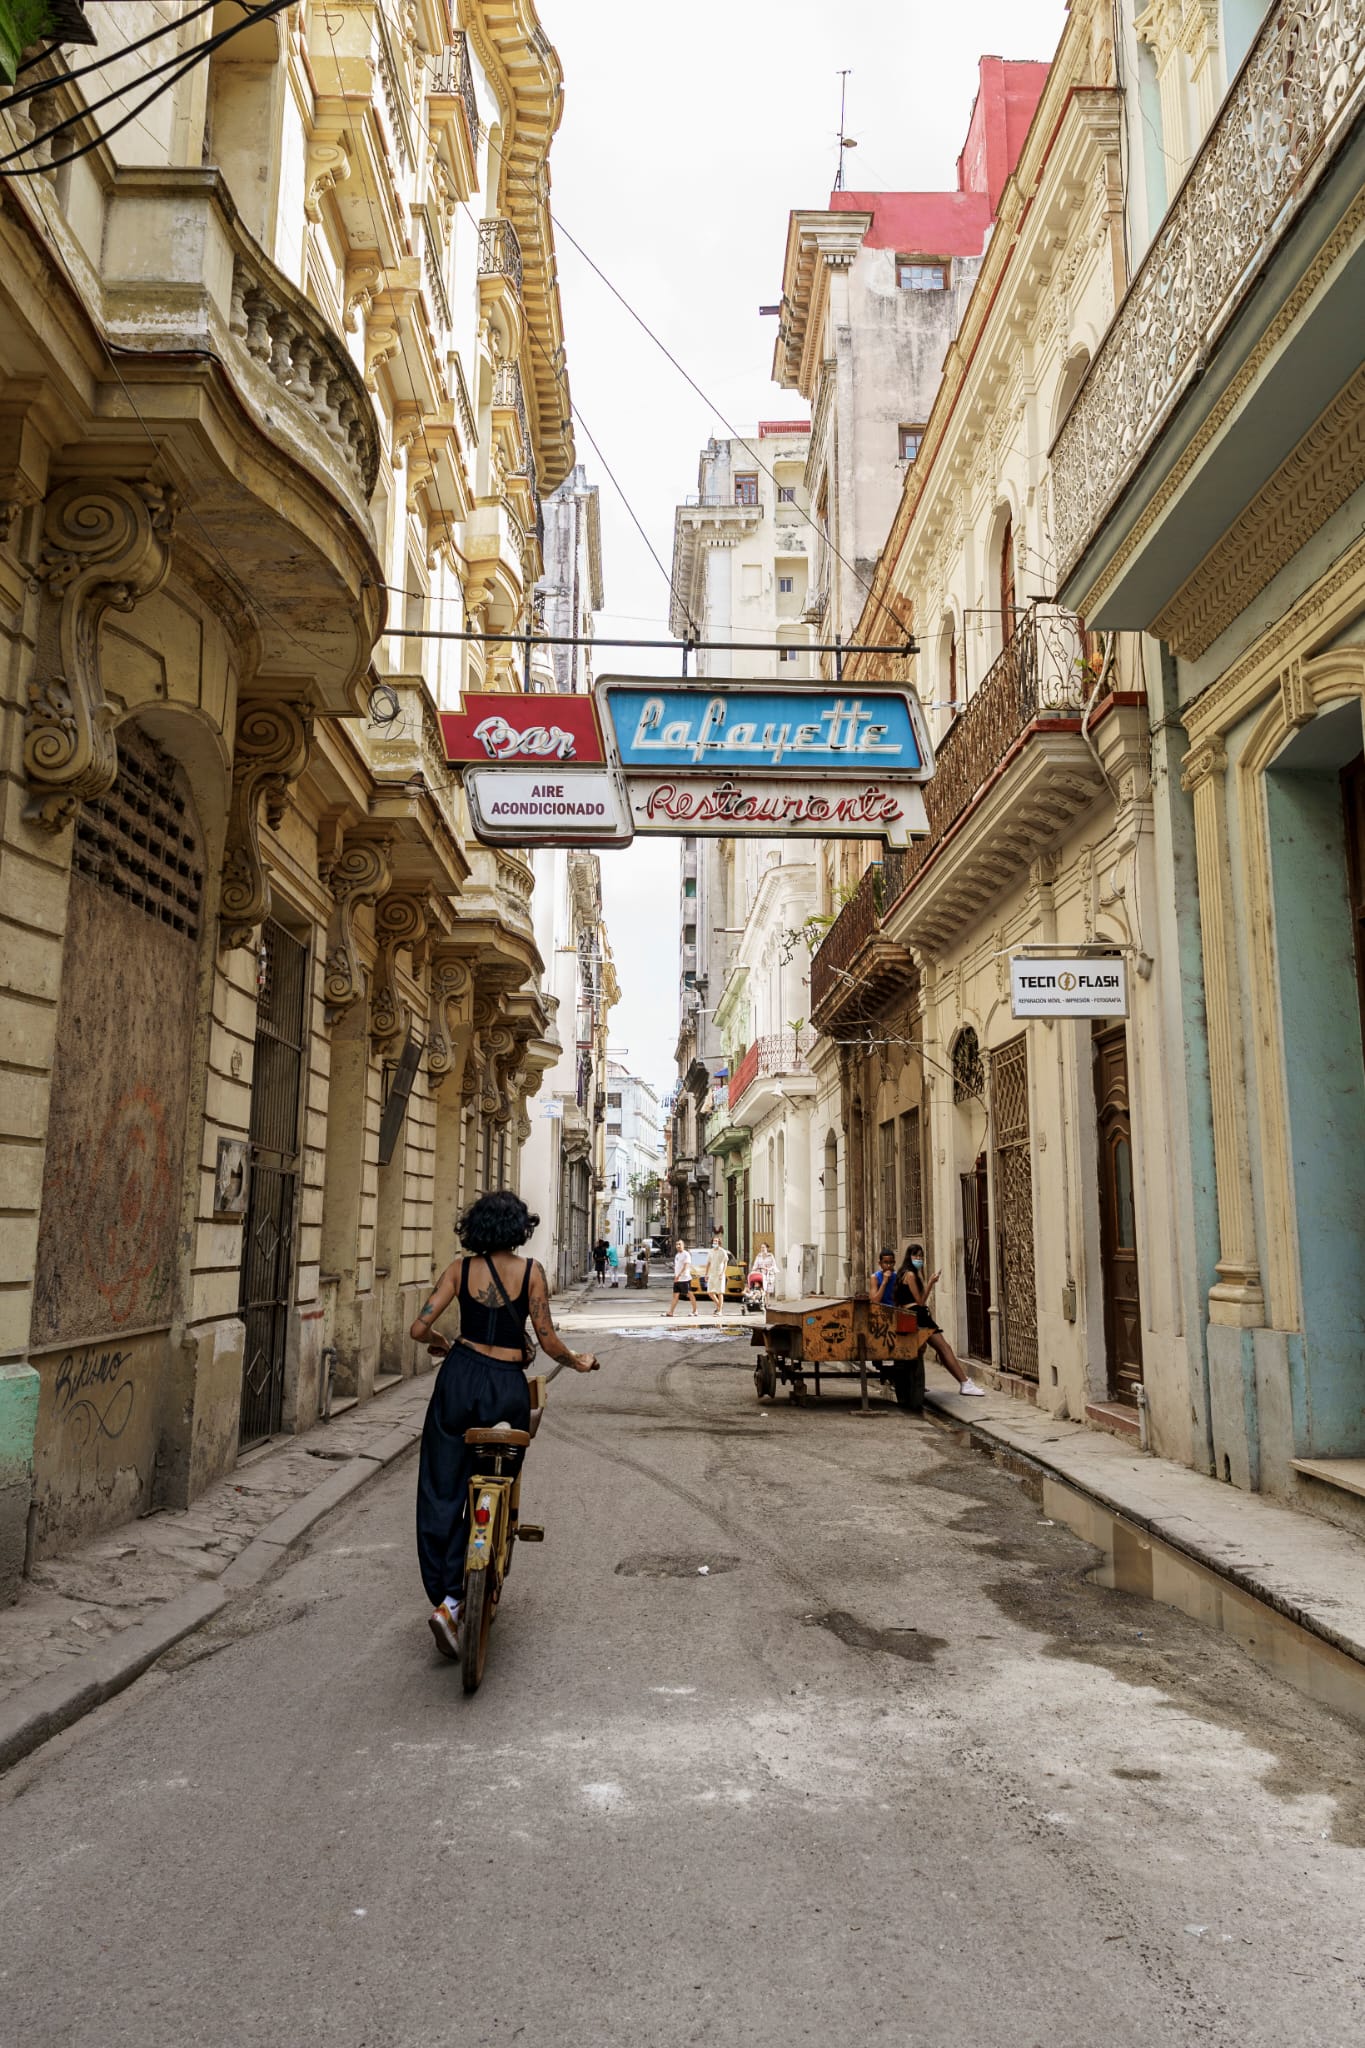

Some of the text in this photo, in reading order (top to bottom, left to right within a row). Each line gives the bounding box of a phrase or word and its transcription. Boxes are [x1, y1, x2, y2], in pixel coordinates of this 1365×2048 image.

[473, 716, 577, 760] Bar
[631, 696, 903, 763] Lafayette
[531, 785, 564, 798] AIRE
[646, 781, 905, 825] Restaurante
[491, 802, 605, 816] ACONDICIONADO
[1078, 975, 1119, 987] FLASH
